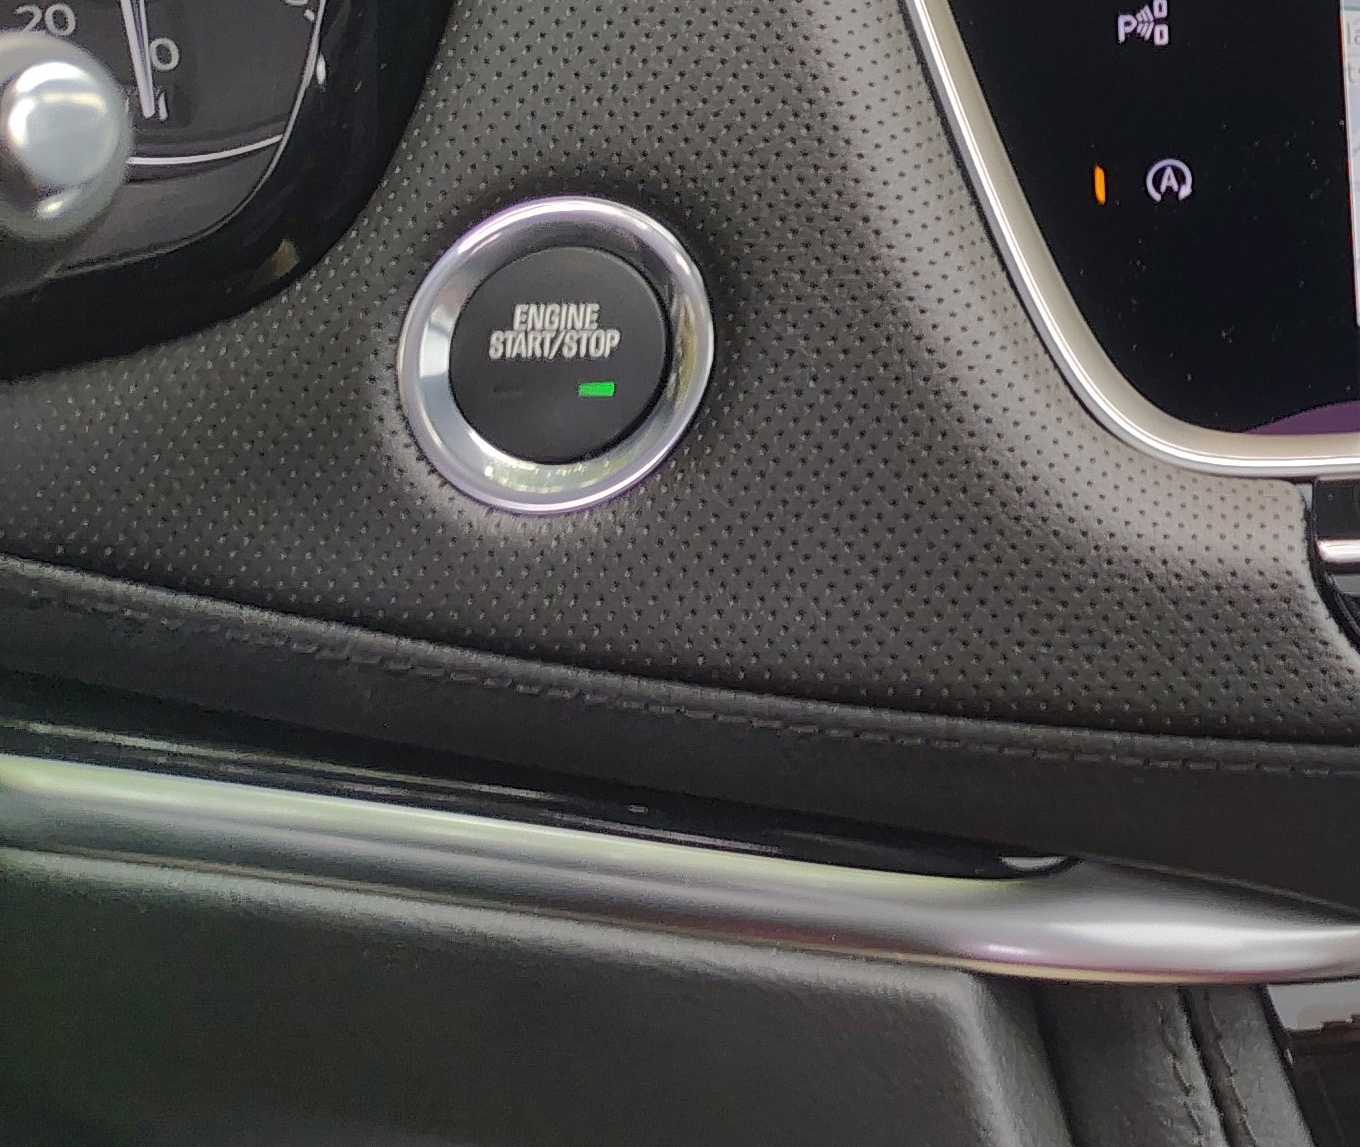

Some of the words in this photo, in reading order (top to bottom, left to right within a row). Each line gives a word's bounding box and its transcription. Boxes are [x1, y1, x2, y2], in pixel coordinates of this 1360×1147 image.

[14, 3, 77, 37] 20
[150, 37, 180, 72] 0
[513, 303, 600, 330] ENGINE
[488, 330, 622, 359] START/STOP
